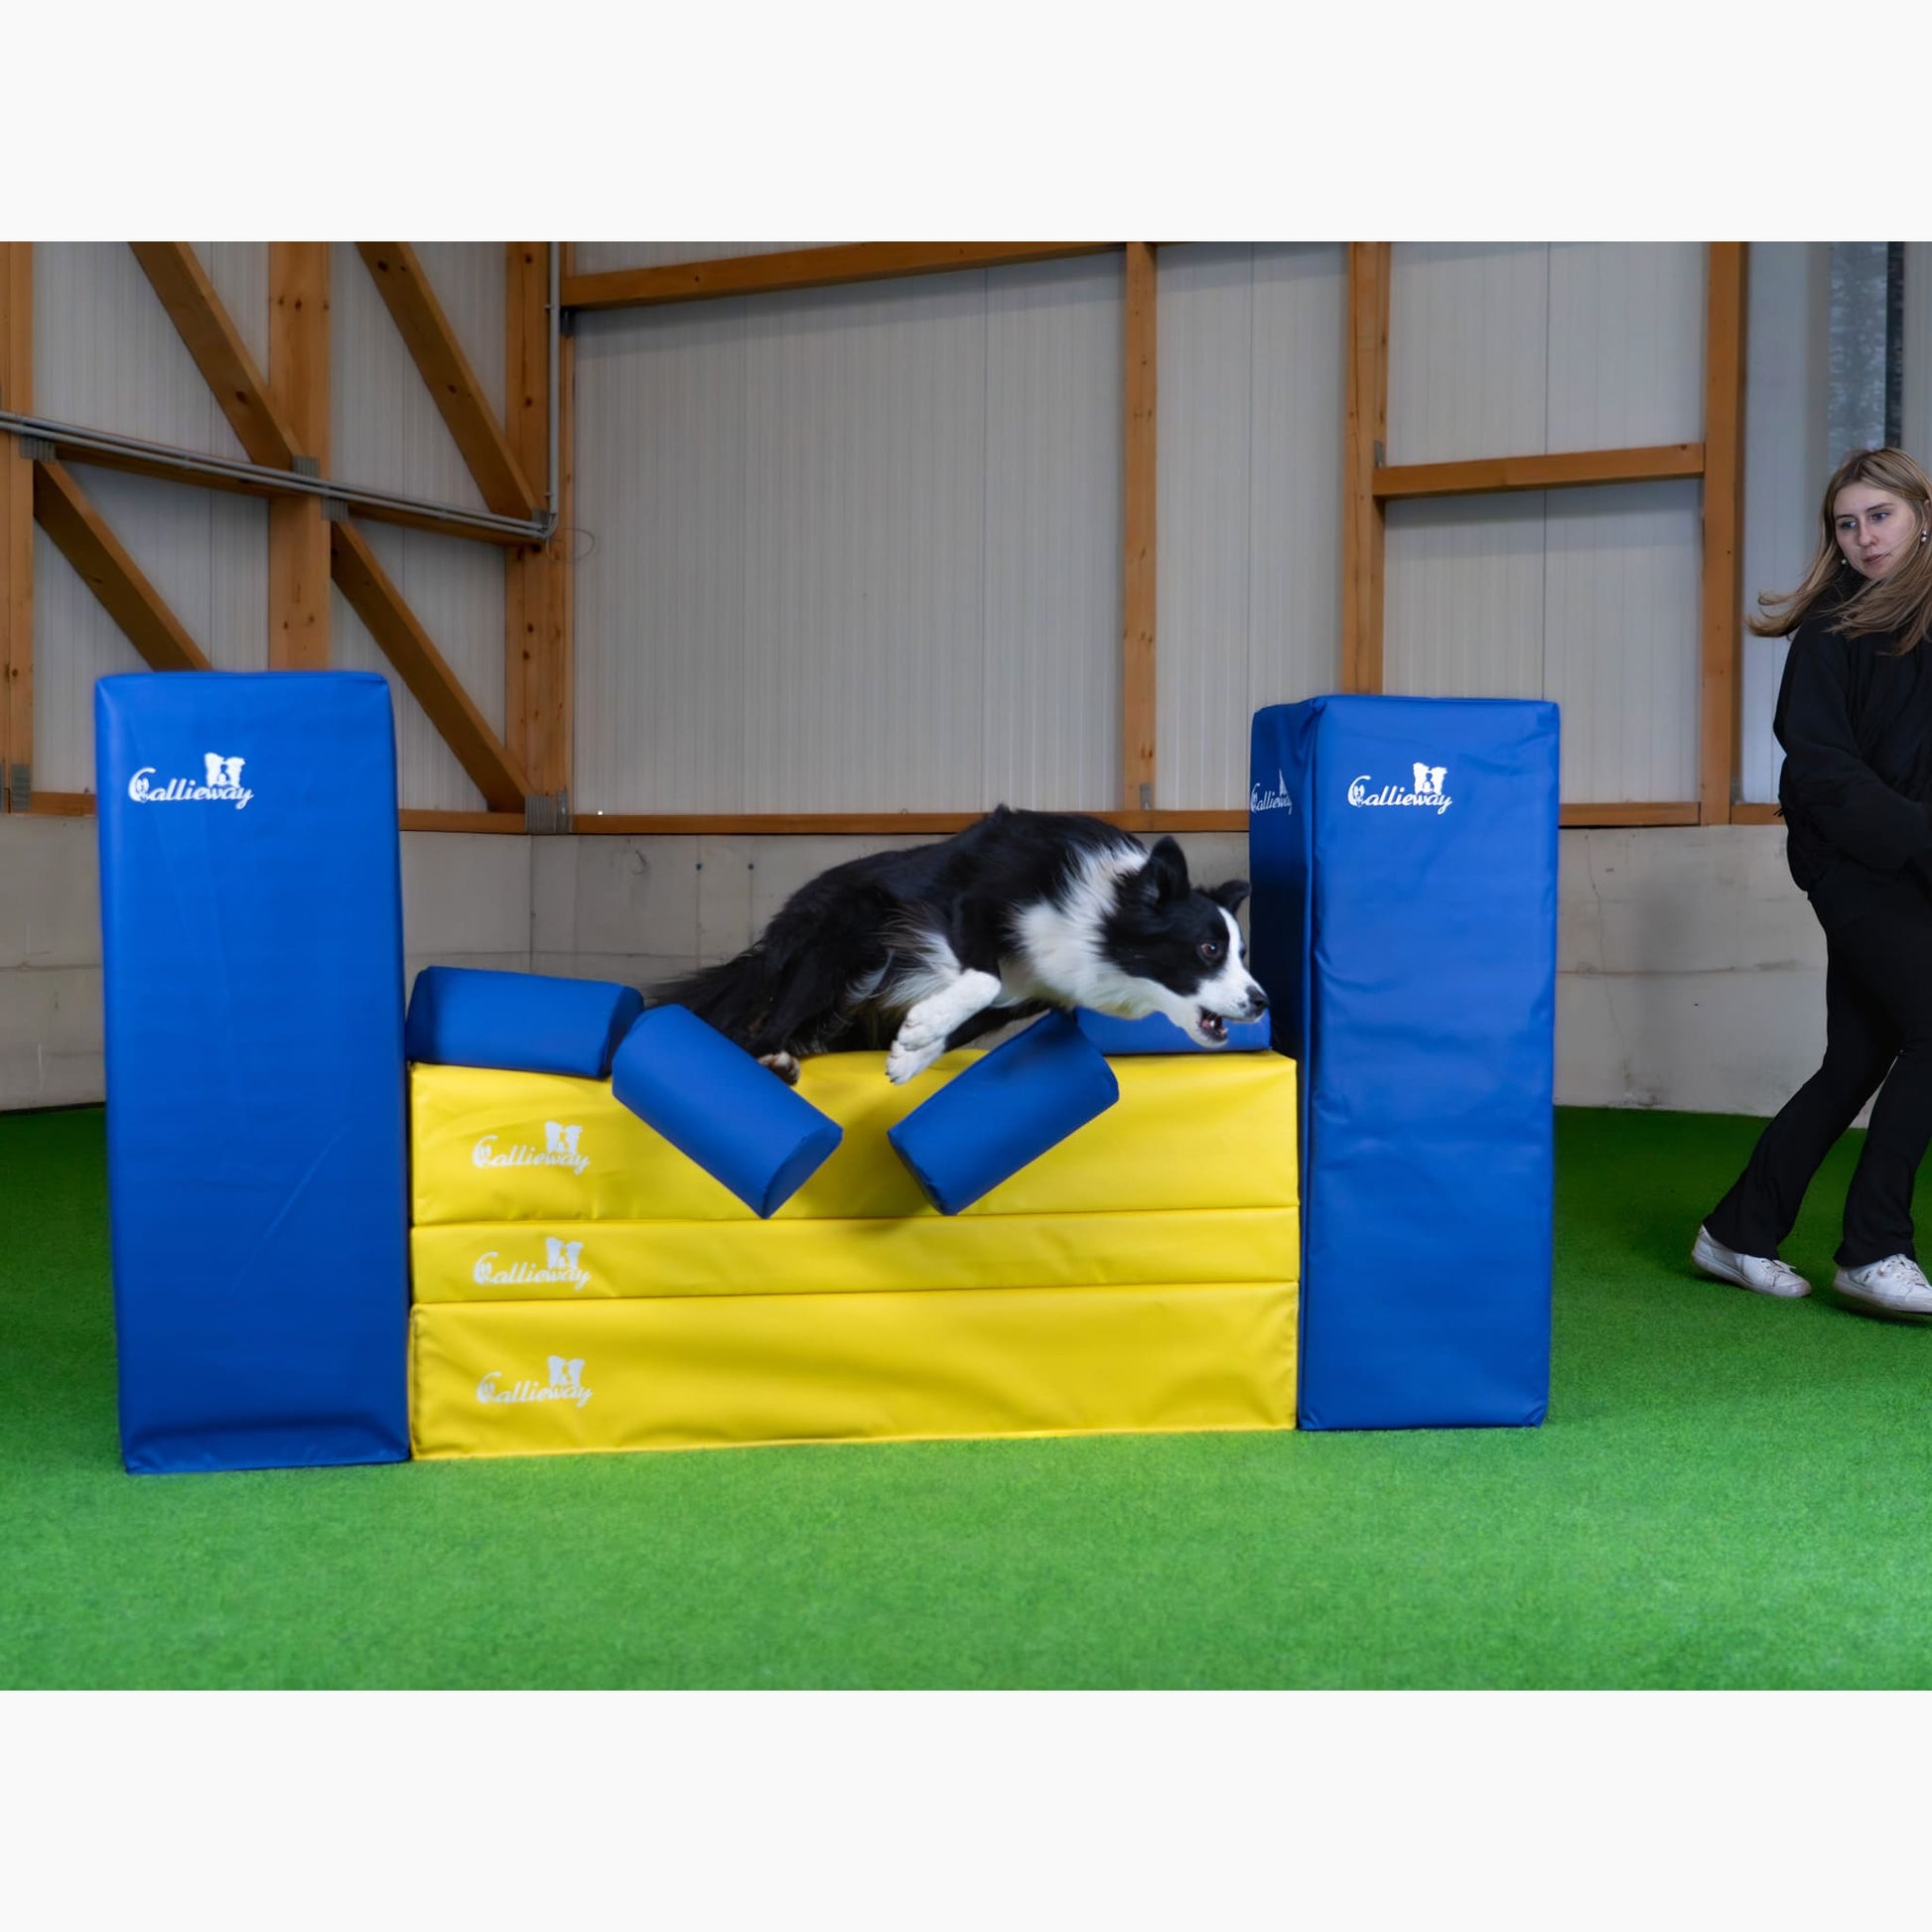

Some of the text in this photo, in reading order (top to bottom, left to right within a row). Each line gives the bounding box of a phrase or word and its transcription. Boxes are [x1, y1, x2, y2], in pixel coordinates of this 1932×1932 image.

[128, 767, 254, 810] Callieway
[1347, 775, 1452, 814] Callieway
[473, 1134, 592, 1175] Callieway
[474, 1251, 592, 1292] Callieway
[477, 1371, 593, 1409] Callieway
